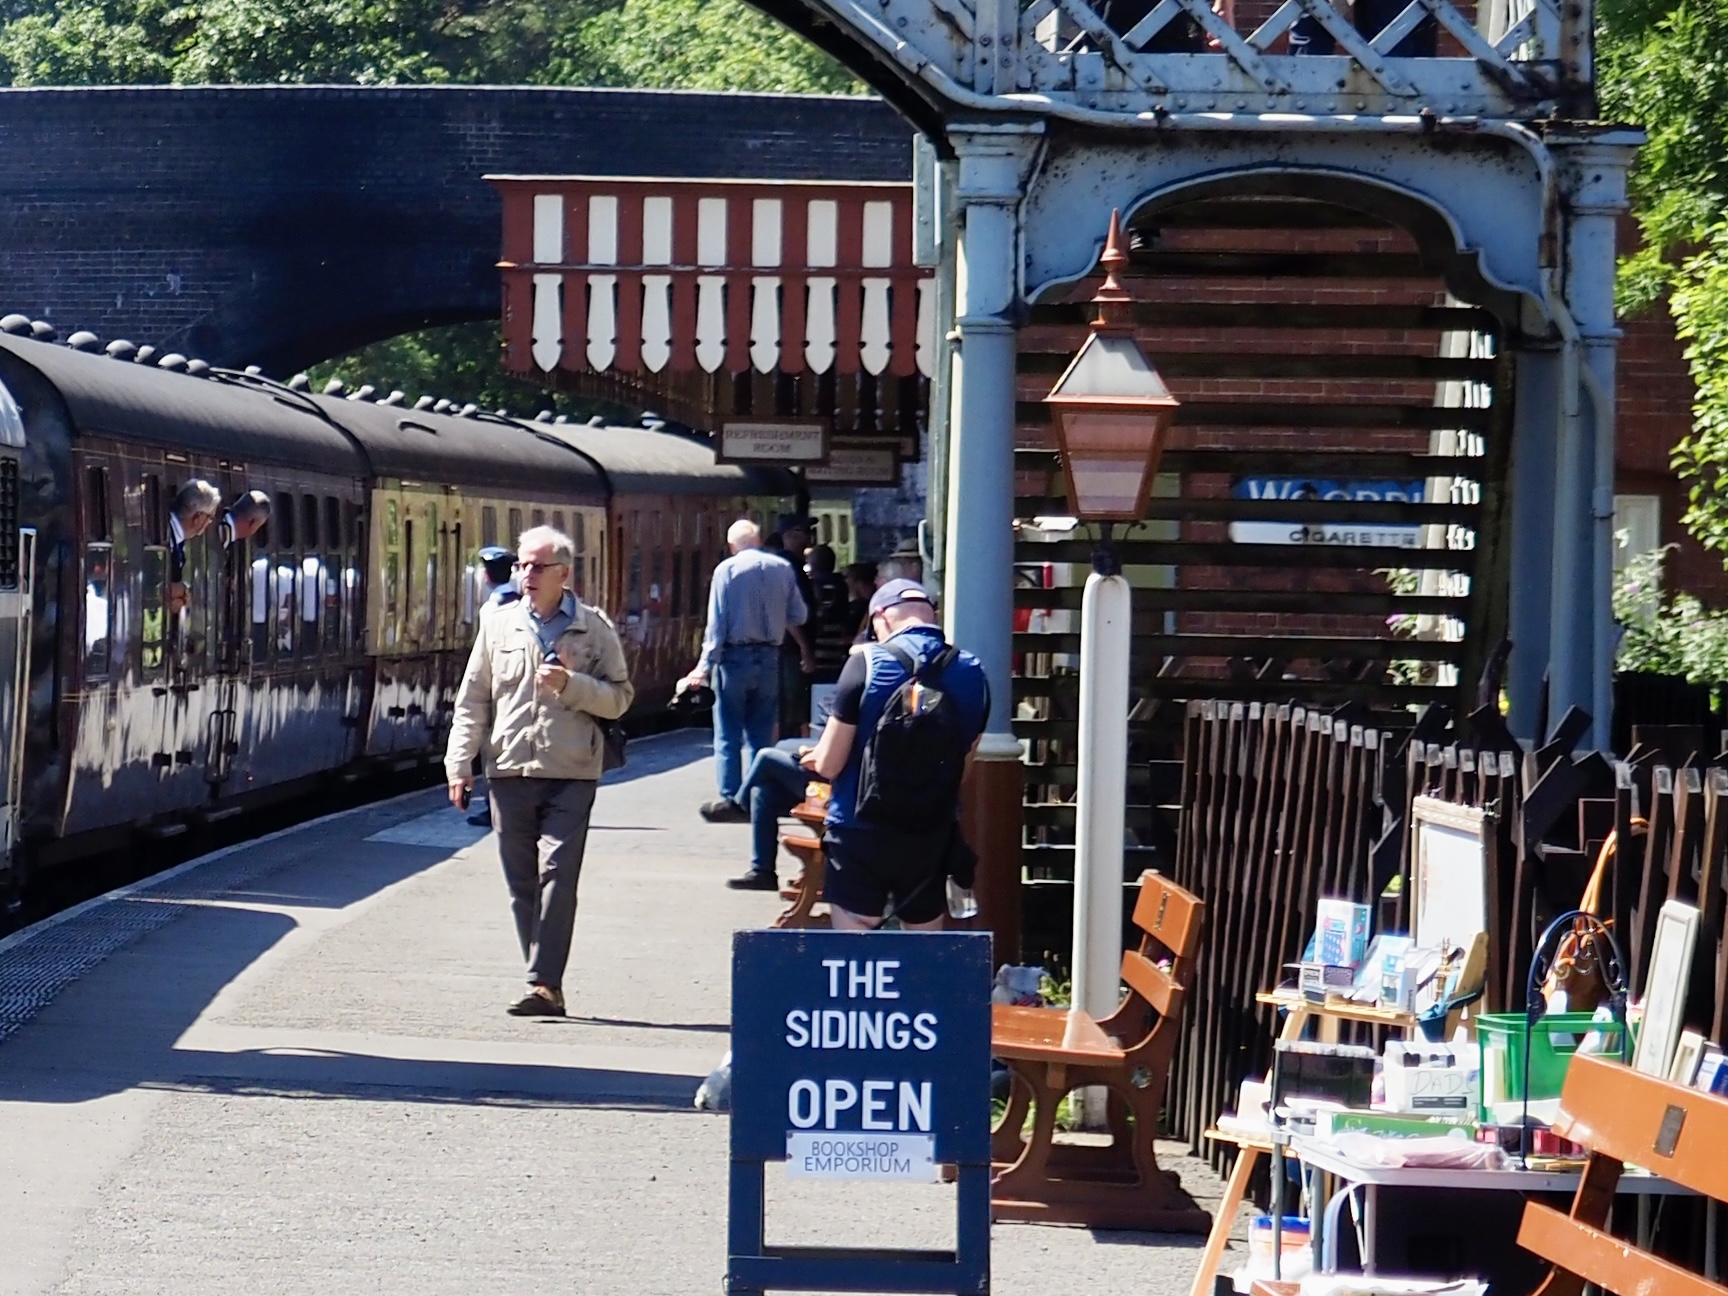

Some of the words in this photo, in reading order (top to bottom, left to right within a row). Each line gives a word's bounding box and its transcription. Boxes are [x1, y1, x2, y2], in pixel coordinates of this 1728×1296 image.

[821, 959, 901, 999] THE
[785, 1009, 938, 1051] SIDINGS
[788, 1079, 932, 1132] OPEN
[804, 1156, 911, 1174] EMPORIUM
[811, 1141, 900, 1158] BOOKSHOP
